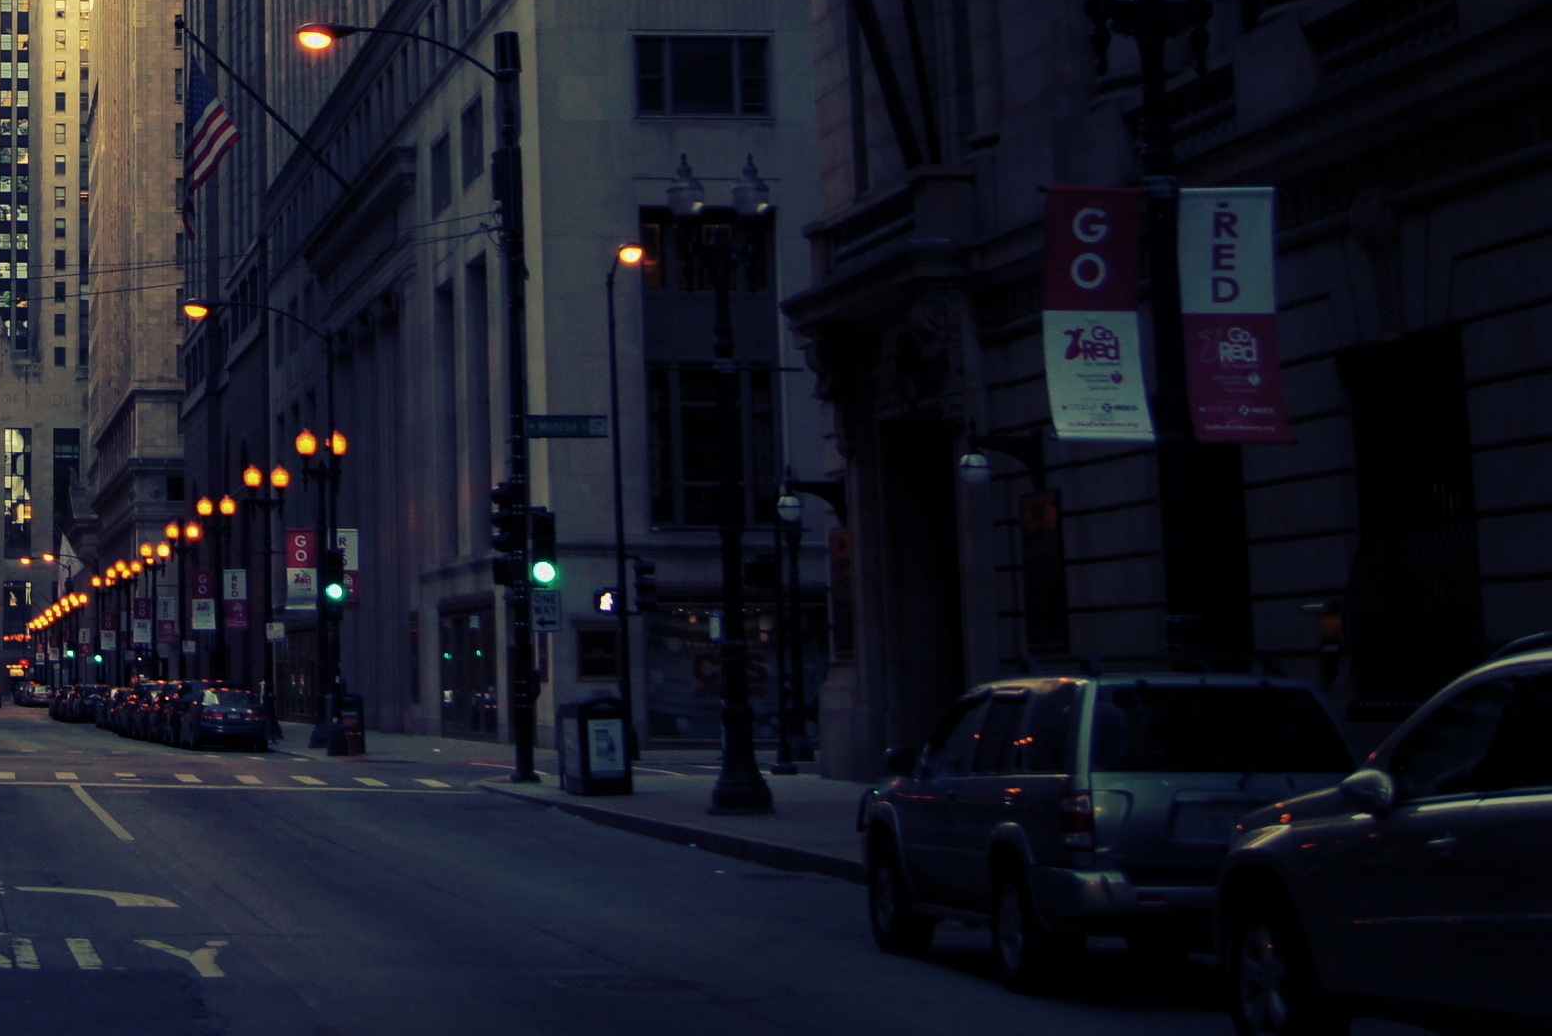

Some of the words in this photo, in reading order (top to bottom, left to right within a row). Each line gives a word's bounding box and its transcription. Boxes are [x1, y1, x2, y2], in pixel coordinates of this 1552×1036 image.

[1070, 207, 1110, 290] GO
[1211, 212, 1239, 303] RED
[26, 392, 70, 406] TRADE
[294, 535, 308, 562] GO
[198, 574, 208, 594] GO
[231, 574, 239, 597] RED
[534, 594, 557, 604] ONE
[534, 605, 557, 614] WAY
[692, 653, 768, 684] CS
